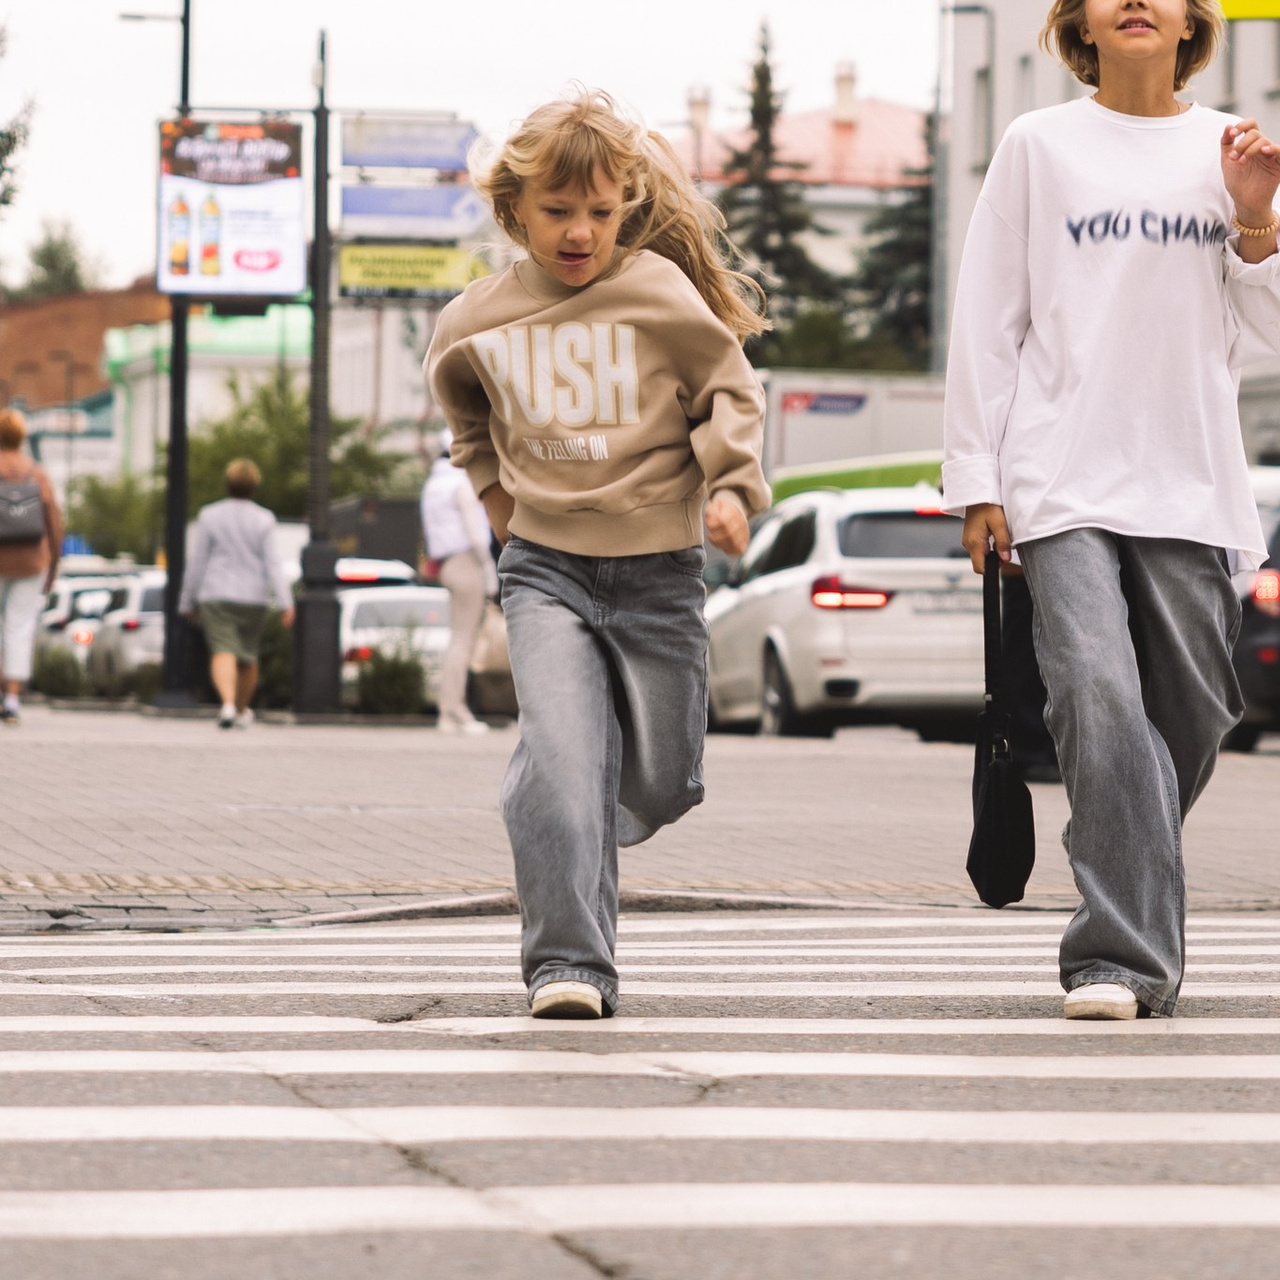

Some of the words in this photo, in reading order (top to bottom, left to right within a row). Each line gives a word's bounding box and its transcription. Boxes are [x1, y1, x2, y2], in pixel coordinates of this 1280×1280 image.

[1066, 206, 1131, 246] YOU
[471, 321, 641, 428] PUSH
[522, 437, 545, 460] THE
[543, 436, 588, 460] FEELING
[589, 434, 608, 460] ON
